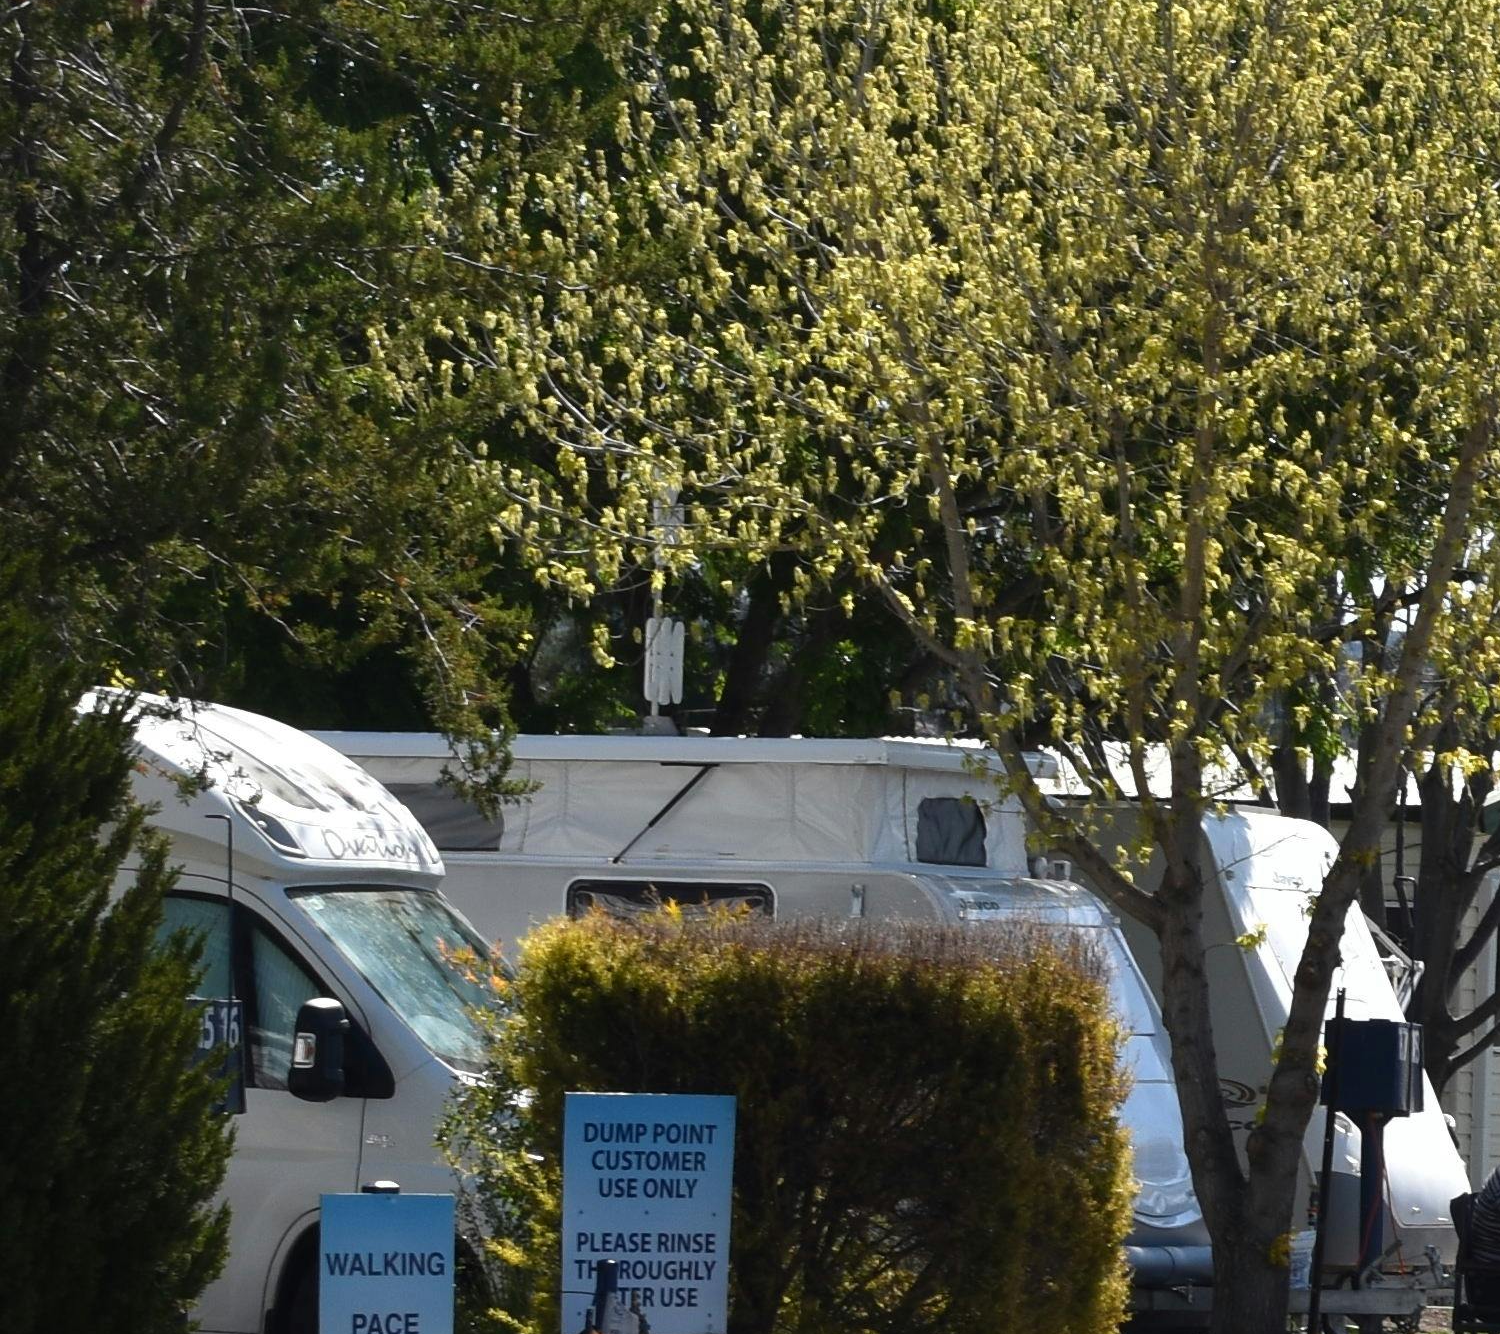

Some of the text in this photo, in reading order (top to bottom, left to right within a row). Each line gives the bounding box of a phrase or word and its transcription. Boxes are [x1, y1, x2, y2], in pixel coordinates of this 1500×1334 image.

[584, 1122, 717, 1144] DUMP POINT
[591, 1150, 706, 1171] CUSTOMER
[599, 1178, 698, 1199] USE ONLY
[577, 1232, 716, 1253] PLEASE RINSE
[326, 1251, 445, 1276] WALKING
[574, 1259, 717, 1281] THROUGHLY
[592, 1287, 698, 1307] TER USE
